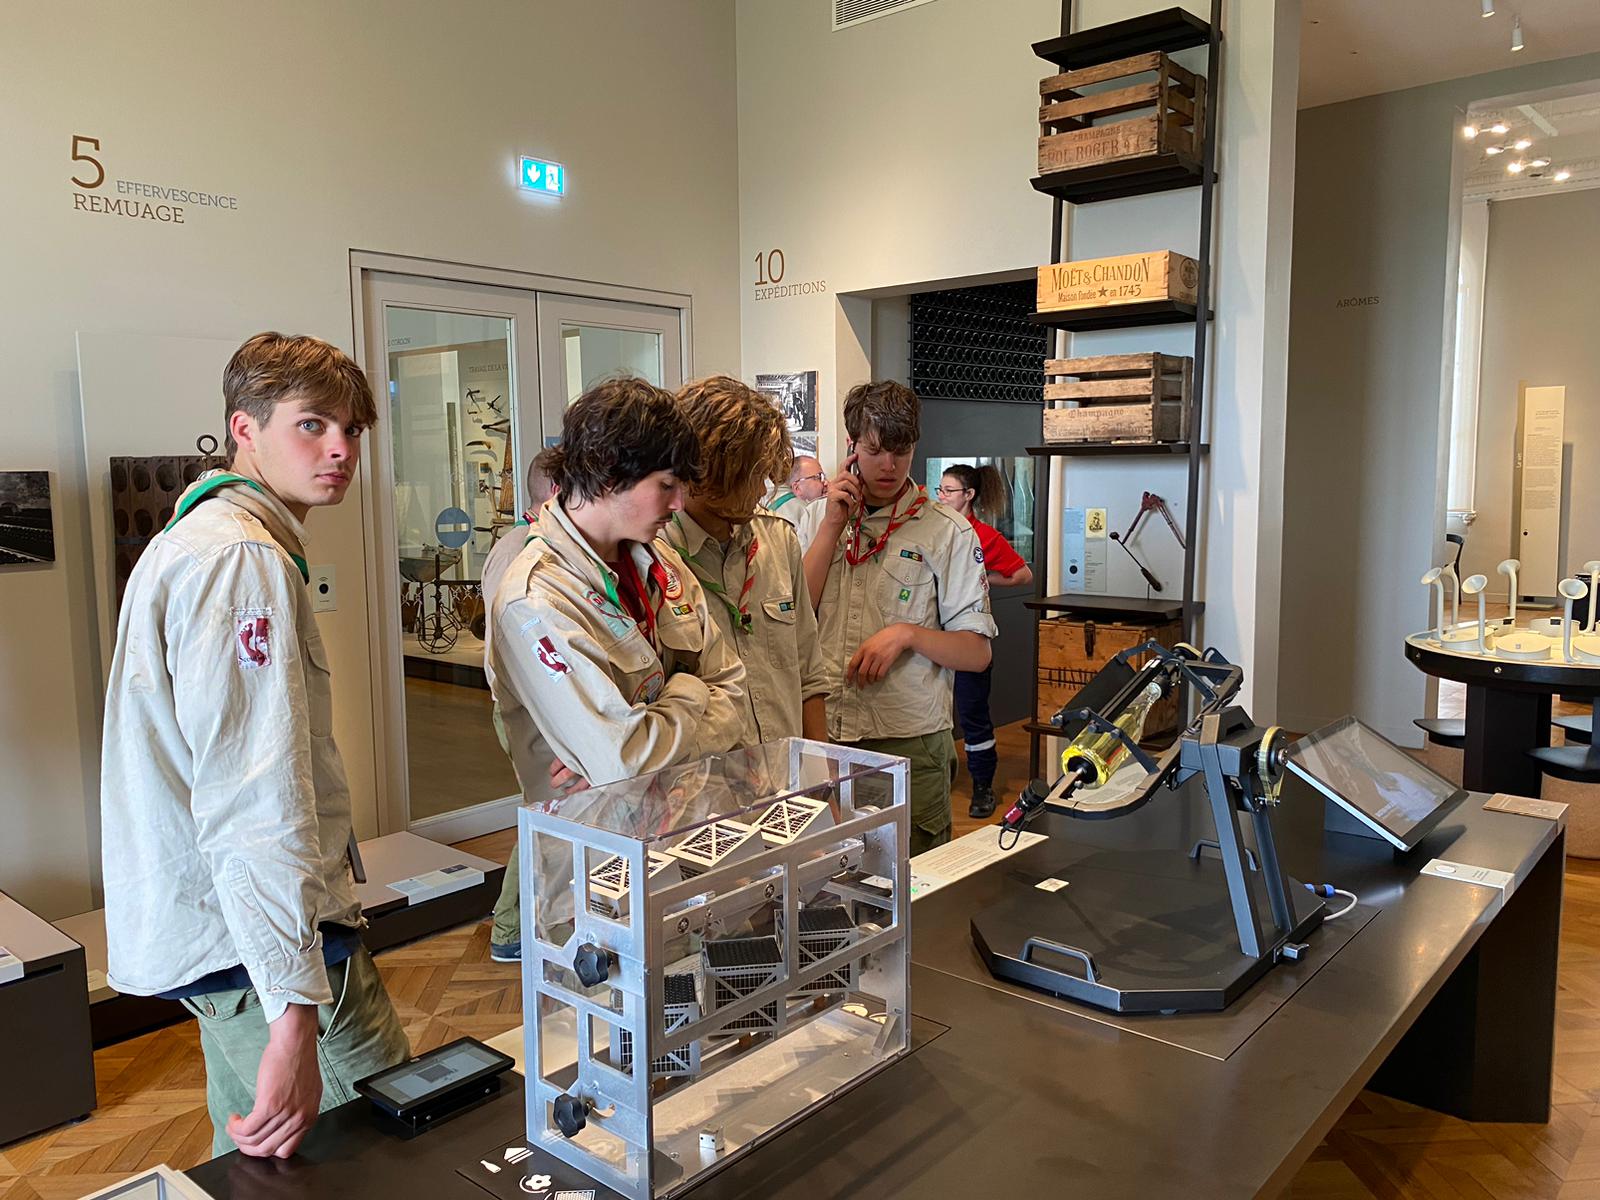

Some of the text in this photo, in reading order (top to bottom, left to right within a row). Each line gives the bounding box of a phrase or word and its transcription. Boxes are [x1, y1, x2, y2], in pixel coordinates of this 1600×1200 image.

[71, 135, 105, 188] 5
[1076, 139, 1119, 160] ROGER
[73, 192, 185, 224] REMUAGE
[116, 180, 238, 210] EFFERVESCENCE
[754, 248, 785, 286] 10
[1093, 256, 1151, 283] CHANDON
[755, 280, 827, 301] EXPÉDITIONS
[1058, 292, 1078, 303] Maison
[1118, 284, 1142, 297] 1743
[1068, 409, 1125, 420] Champagne
